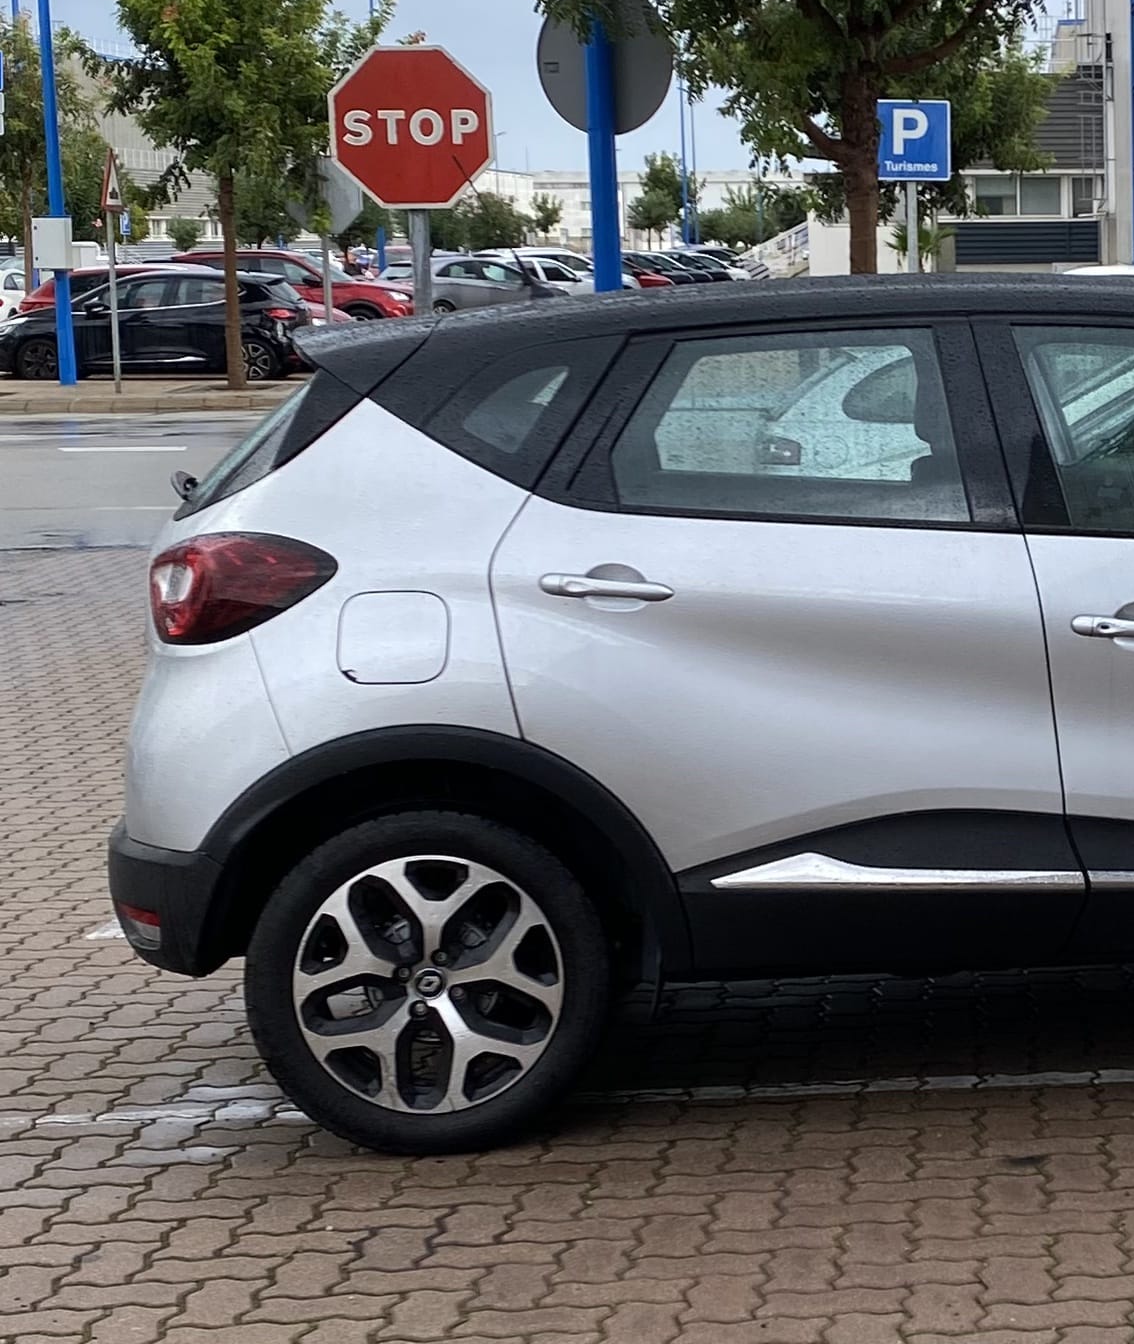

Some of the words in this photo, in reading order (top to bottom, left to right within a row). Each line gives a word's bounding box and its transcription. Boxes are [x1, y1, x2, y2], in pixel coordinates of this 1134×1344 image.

[342, 108, 479, 146] STOP
[892, 108, 929, 155] P
[884, 160, 938, 172] Turismes
